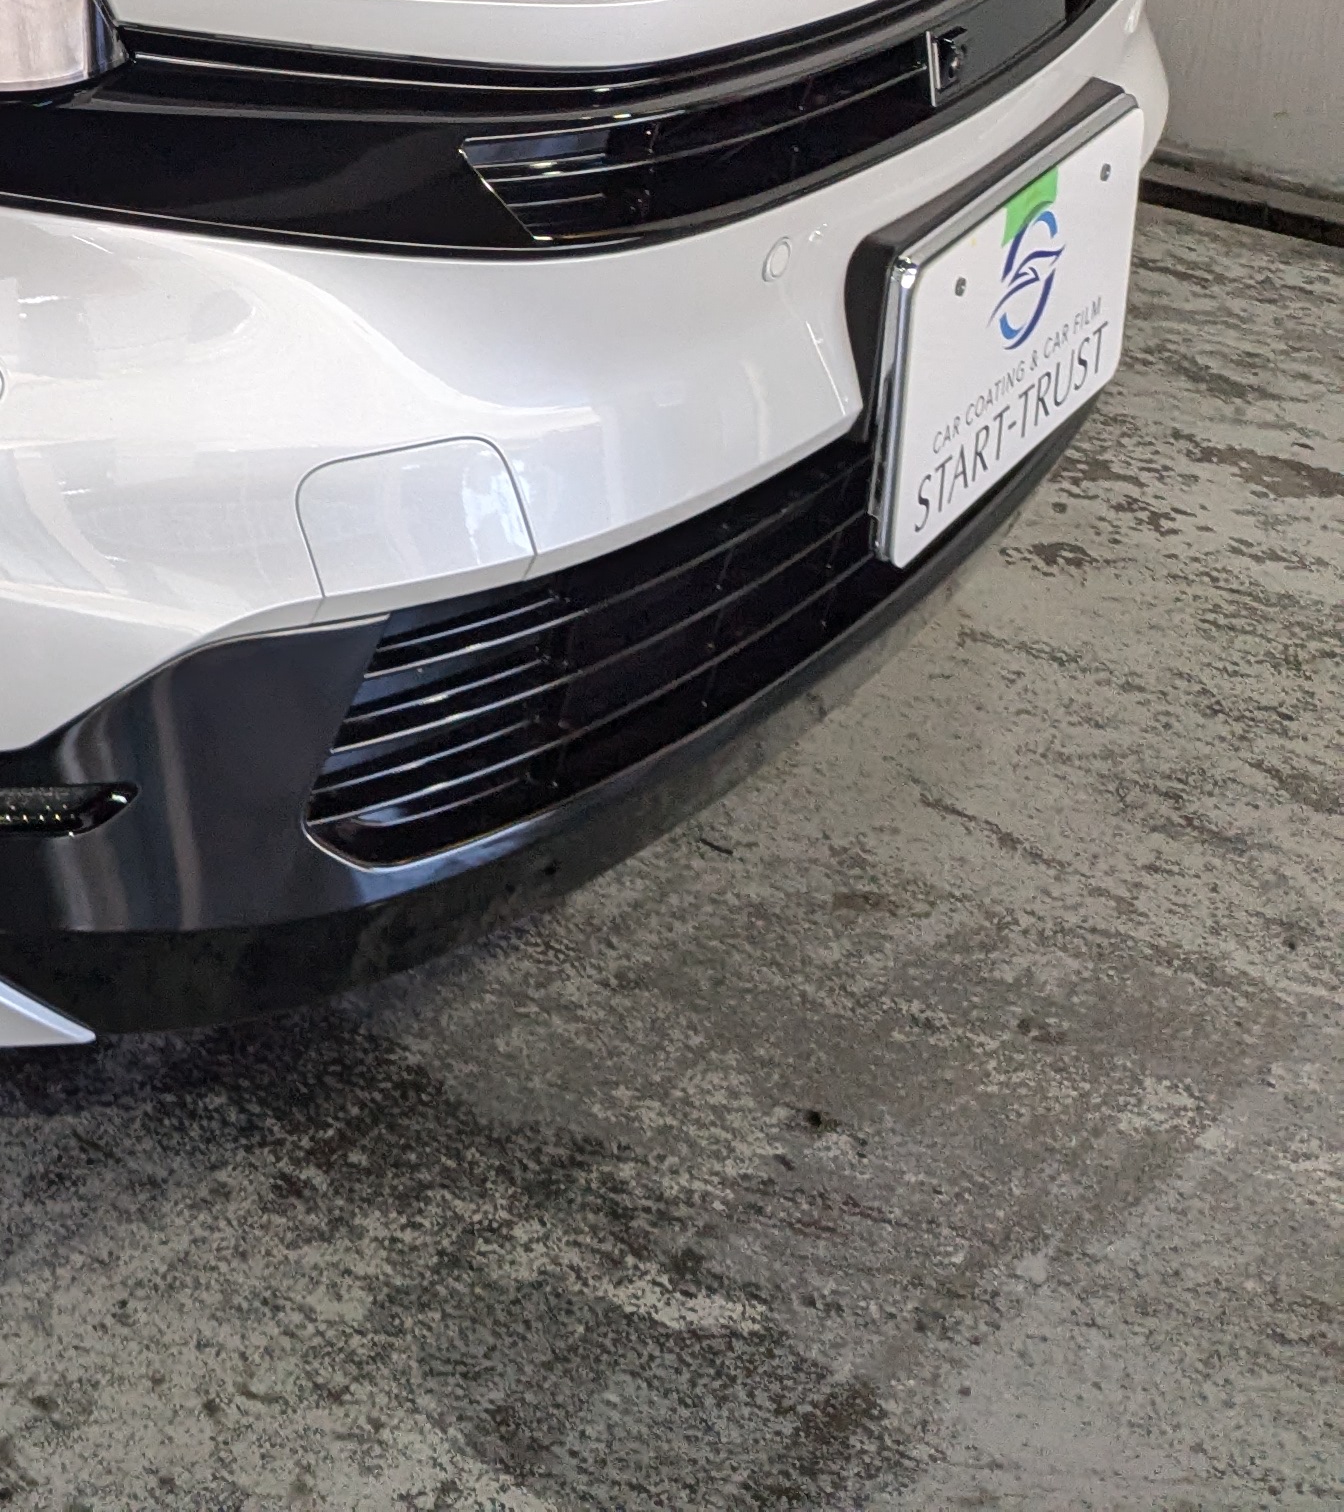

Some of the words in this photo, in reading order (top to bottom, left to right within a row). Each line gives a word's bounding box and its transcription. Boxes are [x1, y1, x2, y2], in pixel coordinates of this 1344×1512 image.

[914, 321, 1108, 532] START-TRUST
[933, 416, 960, 454] CAR
[965, 360, 1025, 426] COATING
[1044, 324, 1069, 358] CAR
[1073, 296, 1101, 334] FILM
